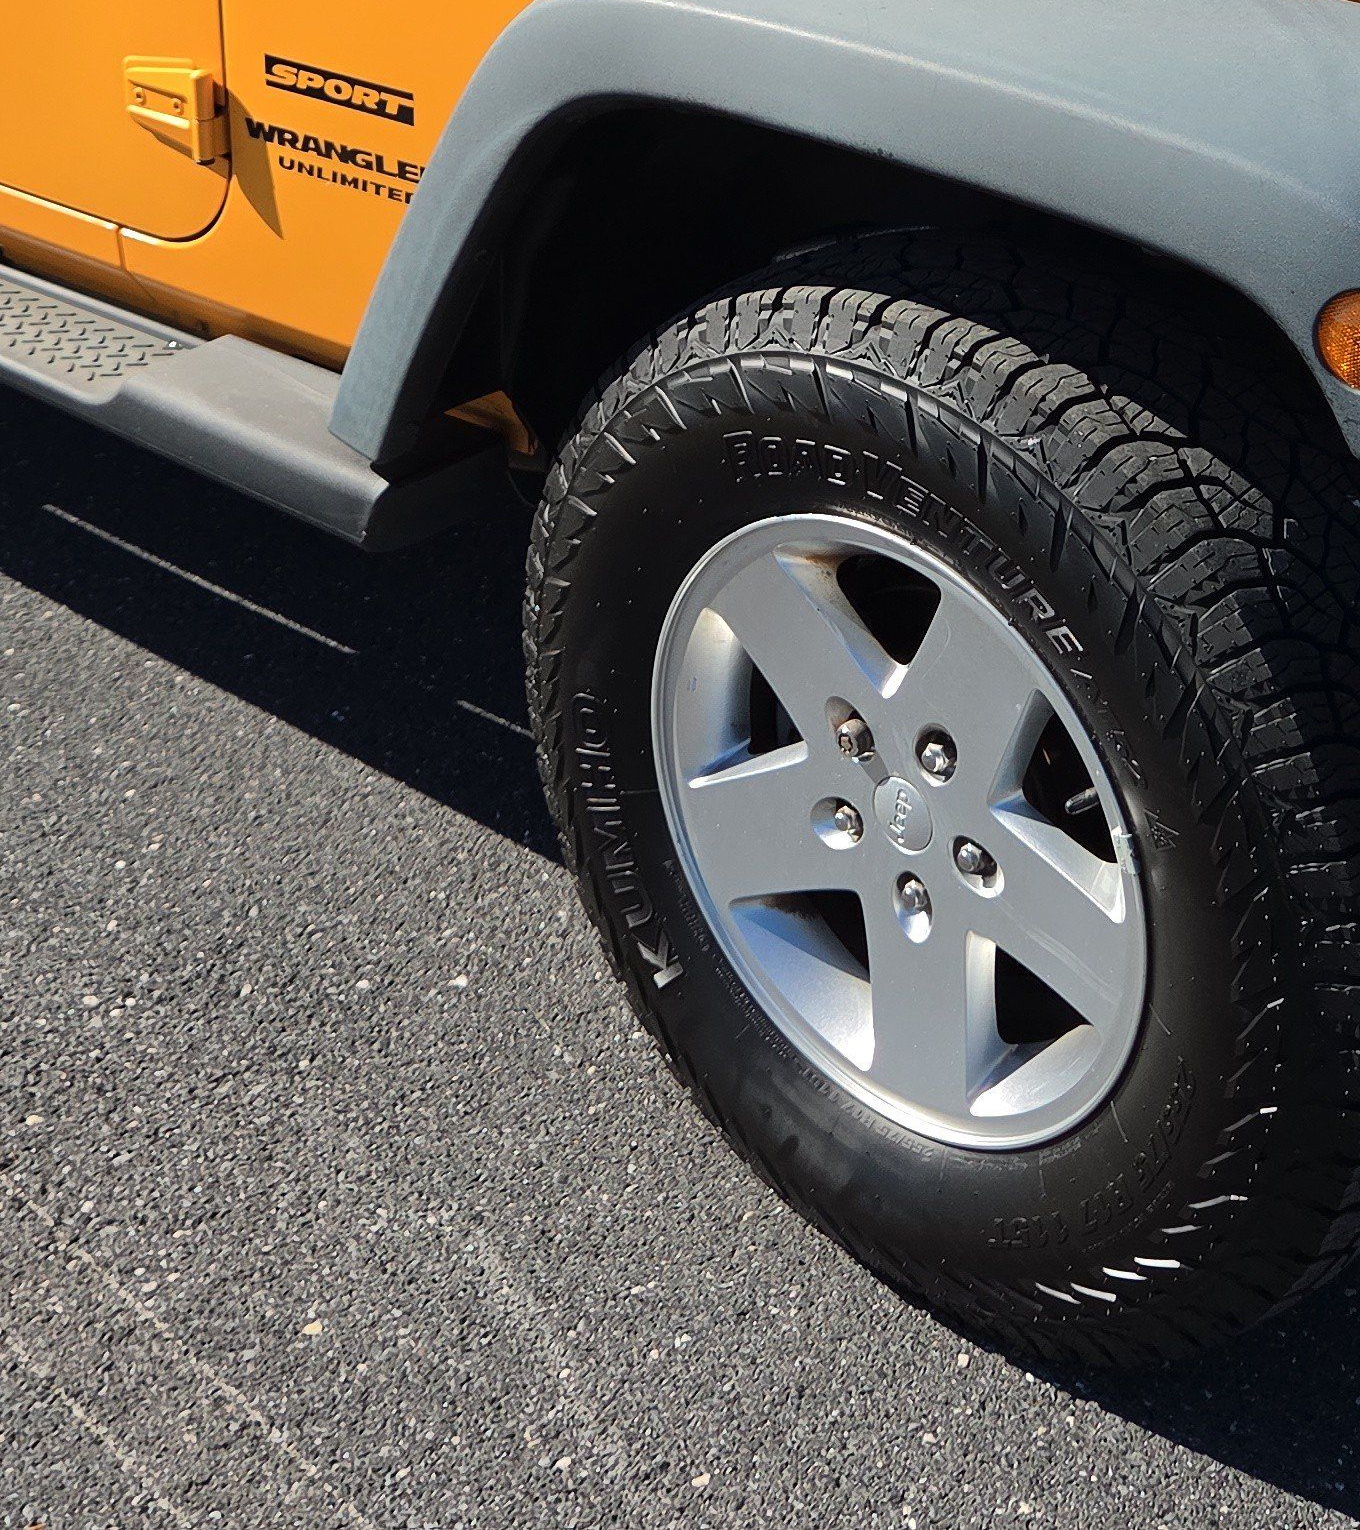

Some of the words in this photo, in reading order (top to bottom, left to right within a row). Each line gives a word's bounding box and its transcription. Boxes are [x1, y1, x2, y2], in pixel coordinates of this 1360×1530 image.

[265, 63, 415, 116] SPORT
[245, 116, 426, 184] WRANGLE
[570, 691, 684, 989] KUMHO
[887, 788, 914, 844] Jeep
